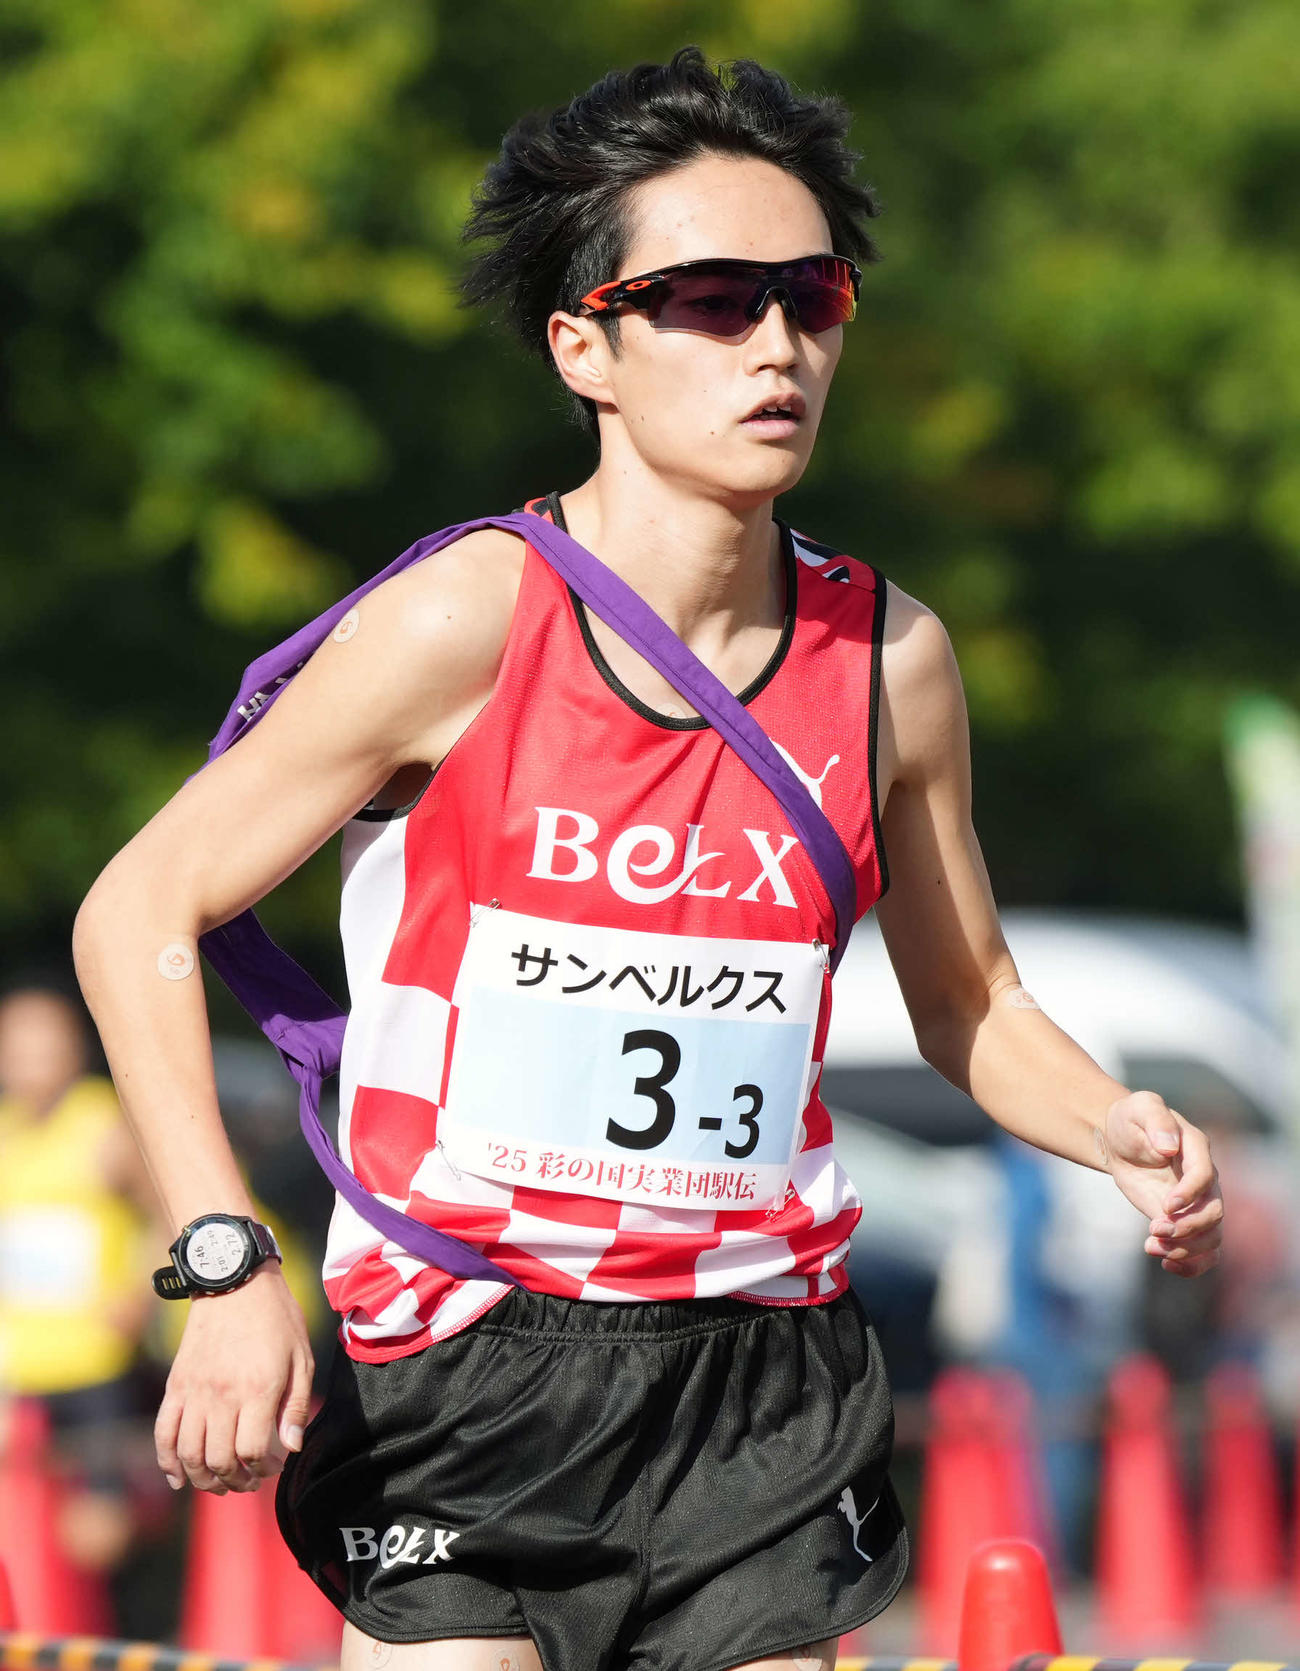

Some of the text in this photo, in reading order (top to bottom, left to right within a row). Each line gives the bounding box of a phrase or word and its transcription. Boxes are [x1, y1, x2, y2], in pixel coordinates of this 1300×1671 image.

[511, 943, 787, 1014] サンベルクス
[535, 1151, 757, 1201] 彩の国実業団駅伝
